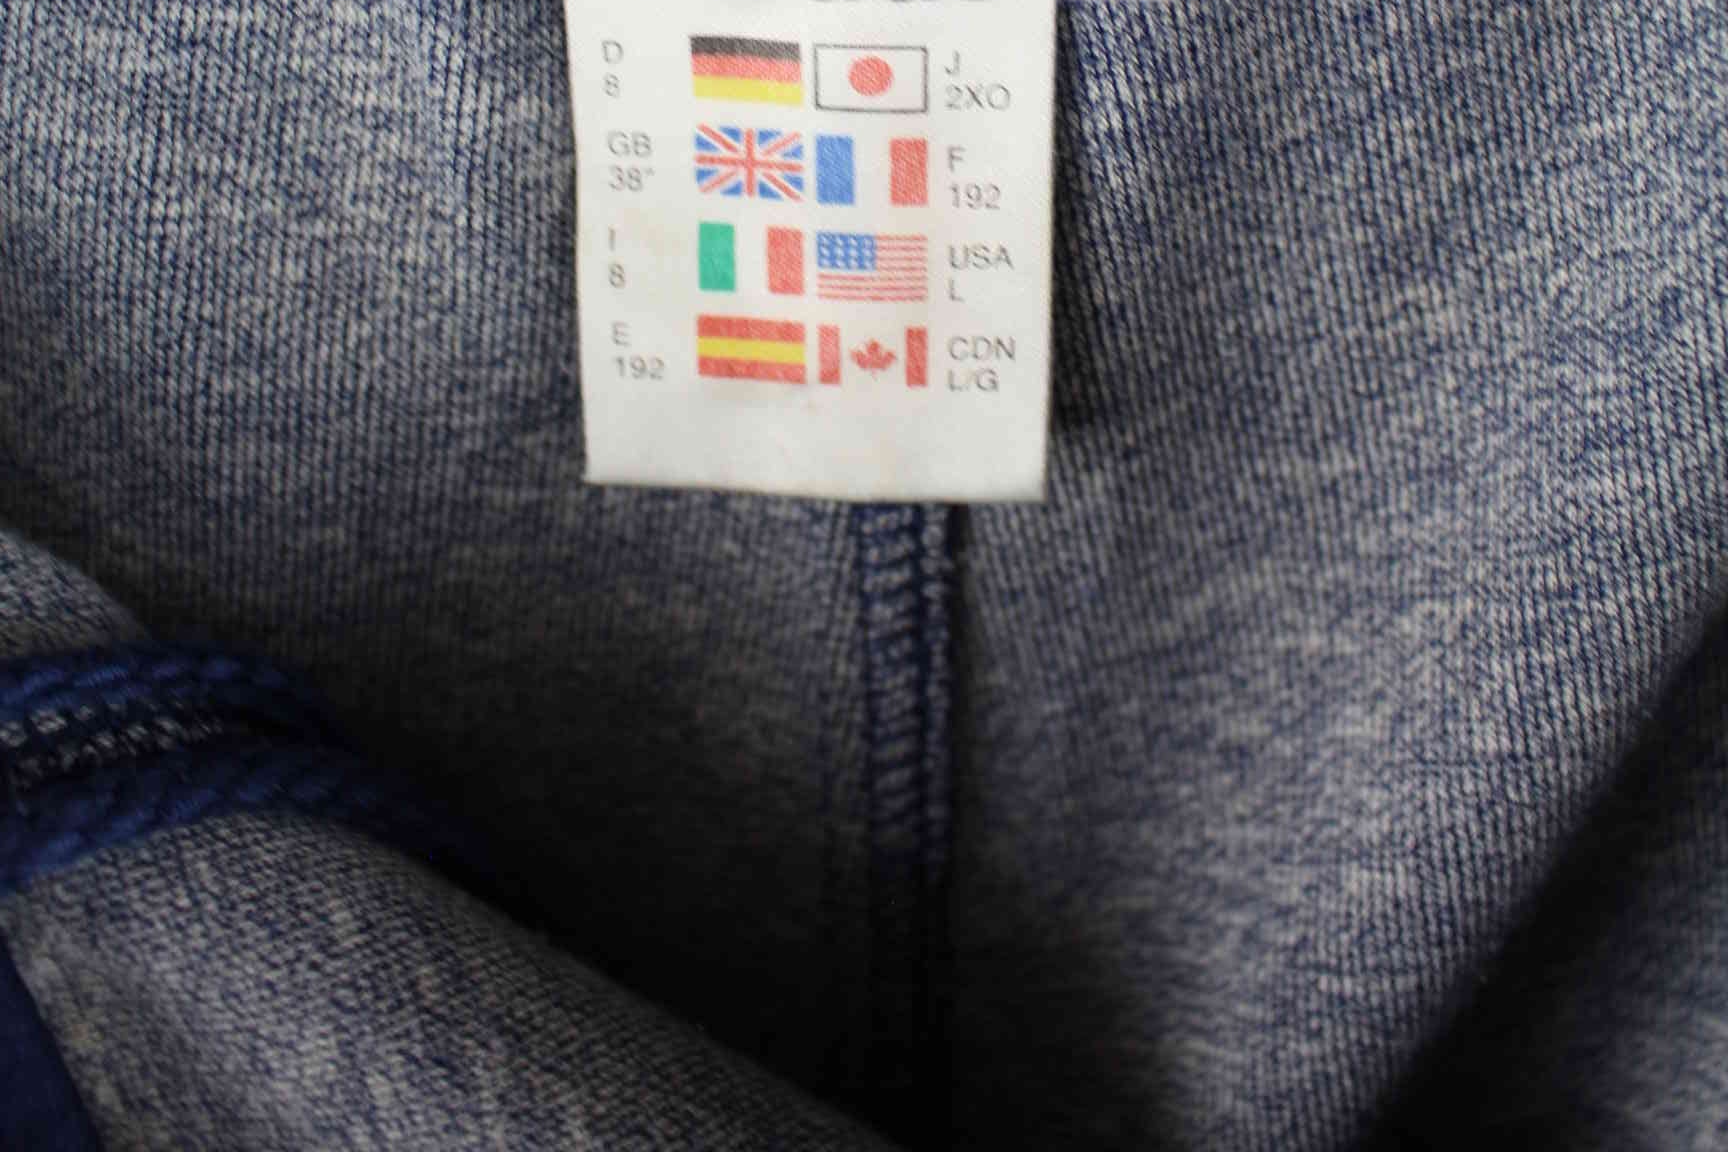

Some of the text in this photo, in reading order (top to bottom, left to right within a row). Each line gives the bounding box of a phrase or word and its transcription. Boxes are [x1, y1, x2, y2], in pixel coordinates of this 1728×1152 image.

[601, 39, 624, 64] D
[944, 51, 961, 77] J
[945, 84, 1011, 111] 2XO
[607, 130, 652, 158] GB
[946, 145, 965, 173] F
[949, 183, 1001, 210] 192
[948, 244, 1014, 271] USA
[608, 262, 626, 288] 8
[947, 277, 965, 303] L
[611, 320, 631, 348] E
[948, 335, 1016, 362] CDN
[614, 355, 665, 381] 192
